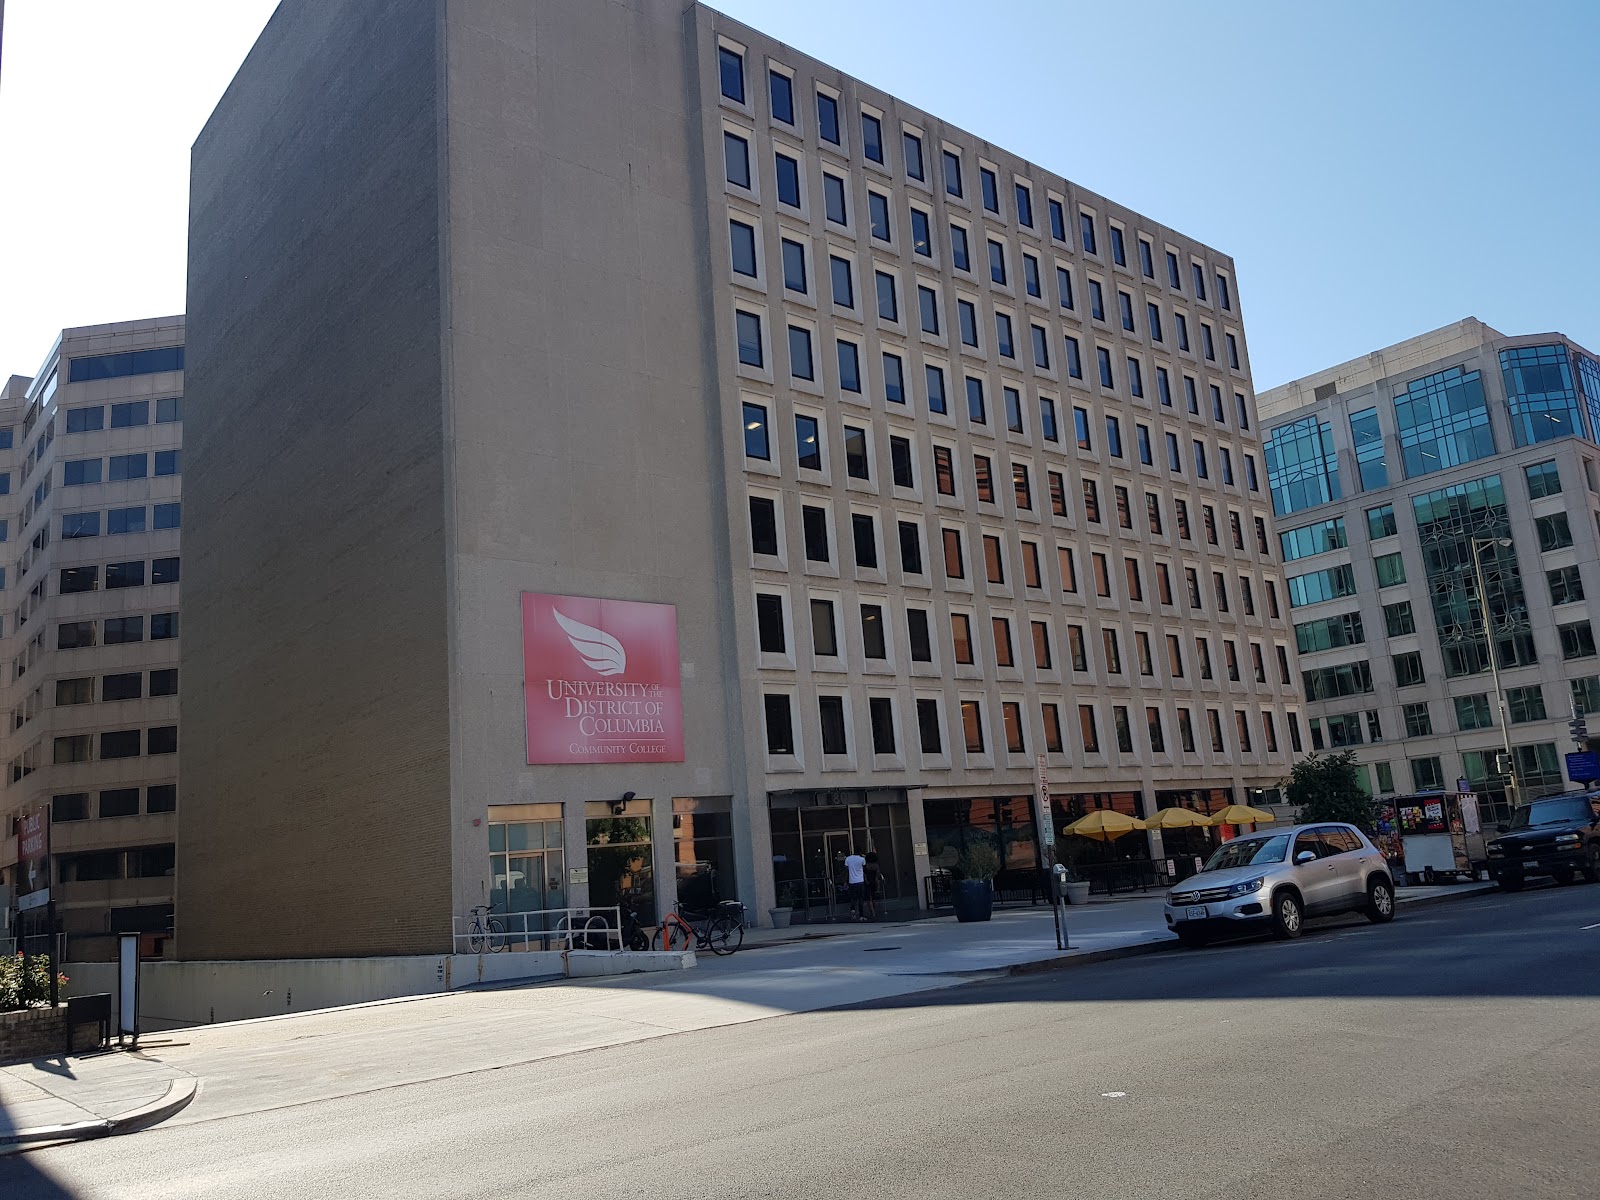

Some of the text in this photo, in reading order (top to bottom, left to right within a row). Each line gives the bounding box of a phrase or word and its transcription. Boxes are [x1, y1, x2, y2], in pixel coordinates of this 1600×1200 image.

[547, 680, 649, 700] UNIVERSITY
[565, 697, 664, 718] DISTRICT OF
[580, 716, 664, 736] COLUMBIA
[569, 742, 667, 754] COMMUNITY COLLEGE
[24, 813, 40, 835] PUBLIC
[22, 833, 41, 855] PARKING
